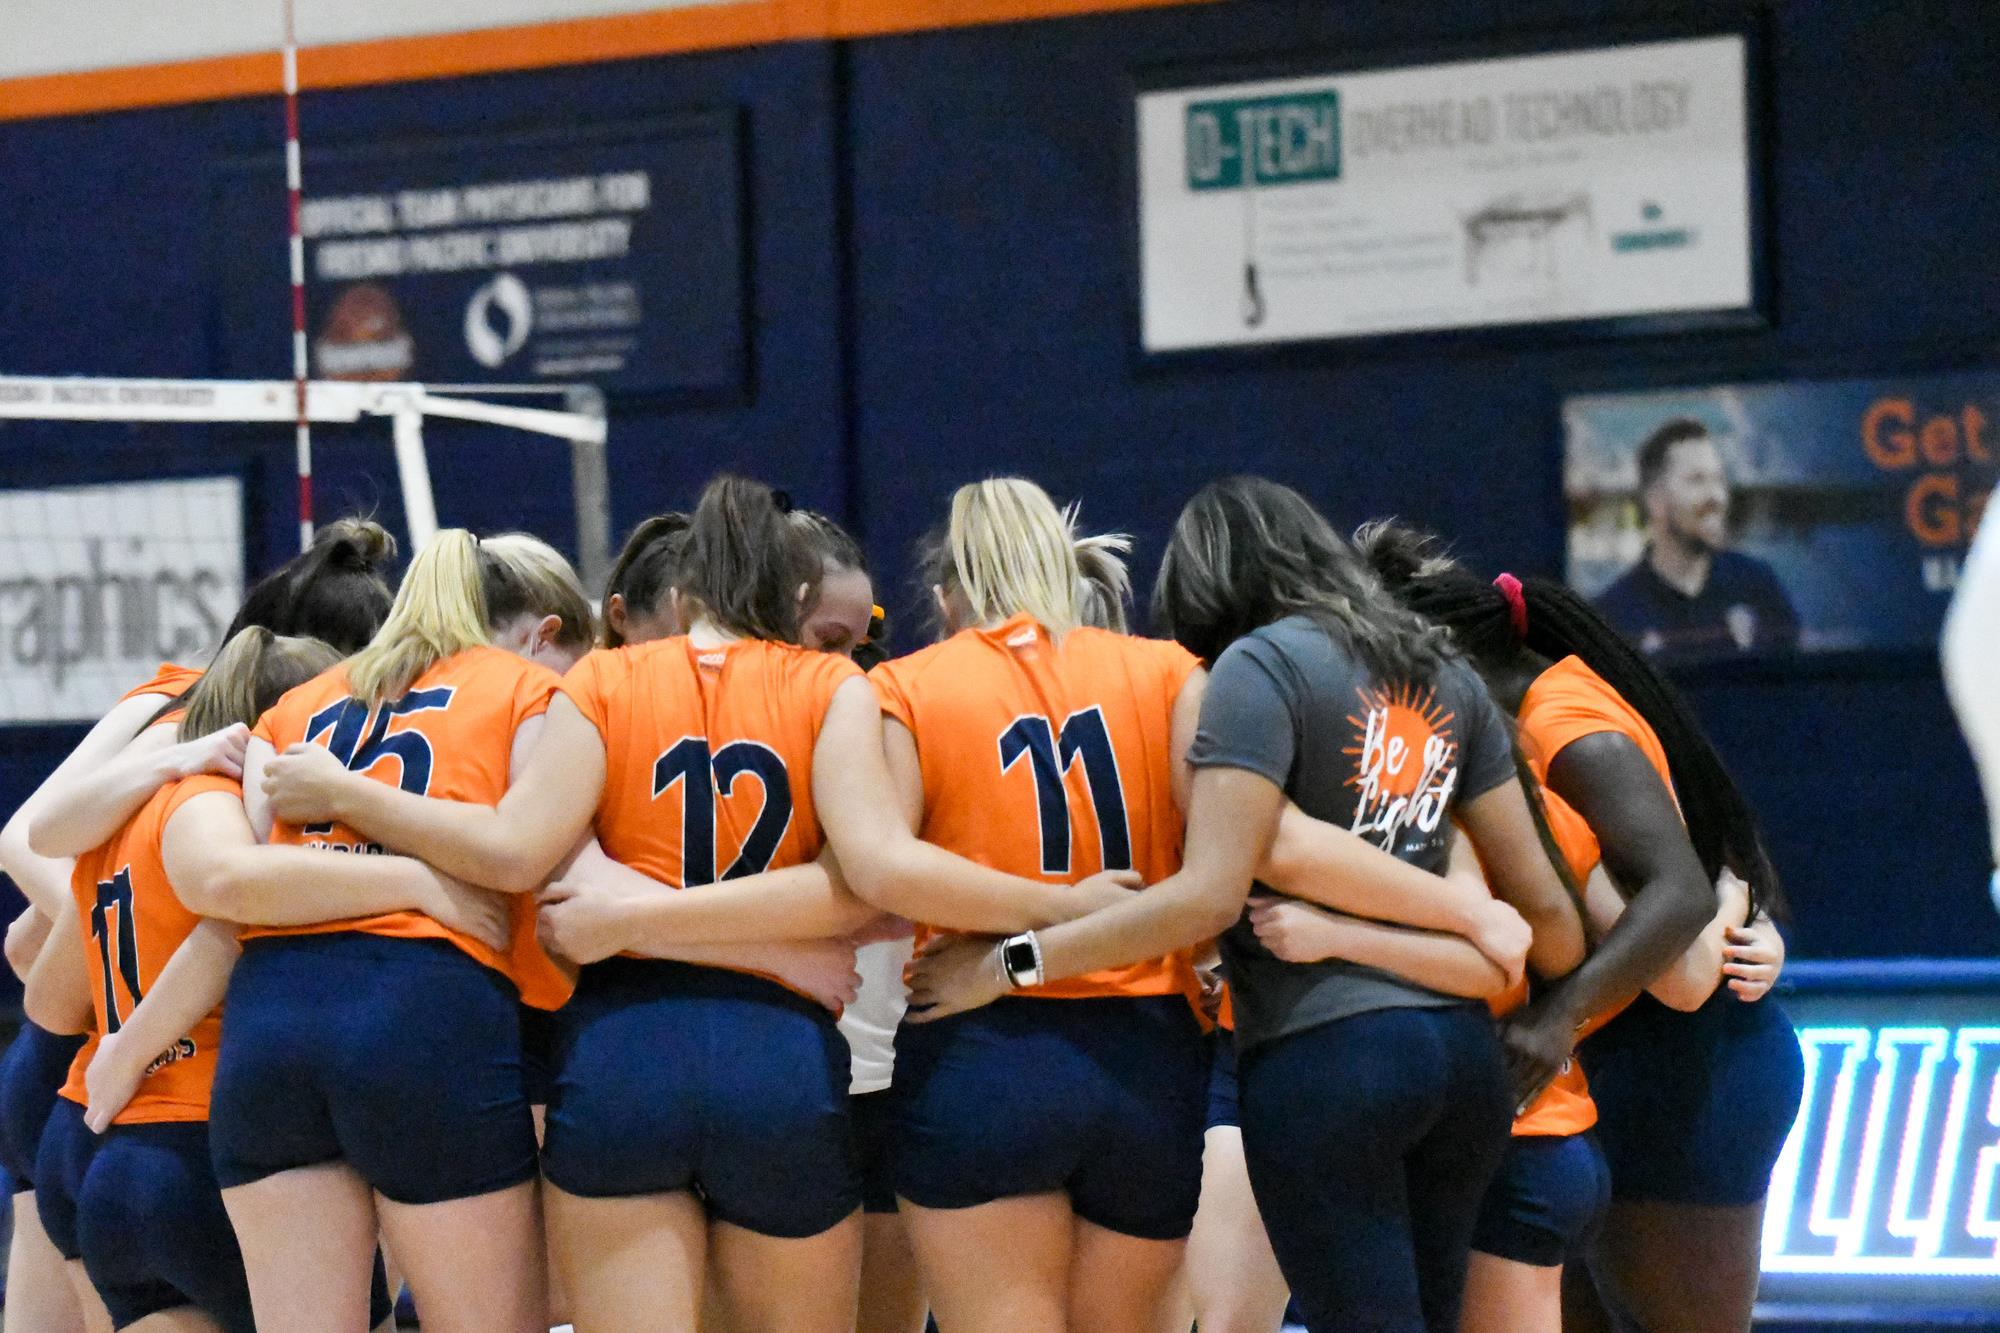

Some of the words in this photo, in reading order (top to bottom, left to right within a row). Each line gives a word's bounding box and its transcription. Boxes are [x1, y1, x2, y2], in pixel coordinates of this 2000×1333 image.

[0, 536, 224, 690] aphics
[303, 686, 458, 836] 15
[651, 734, 795, 889] 12
[997, 703, 1134, 875] 11
[1351, 766, 1458, 854] Light
[1360, 707, 1409, 775] Be
